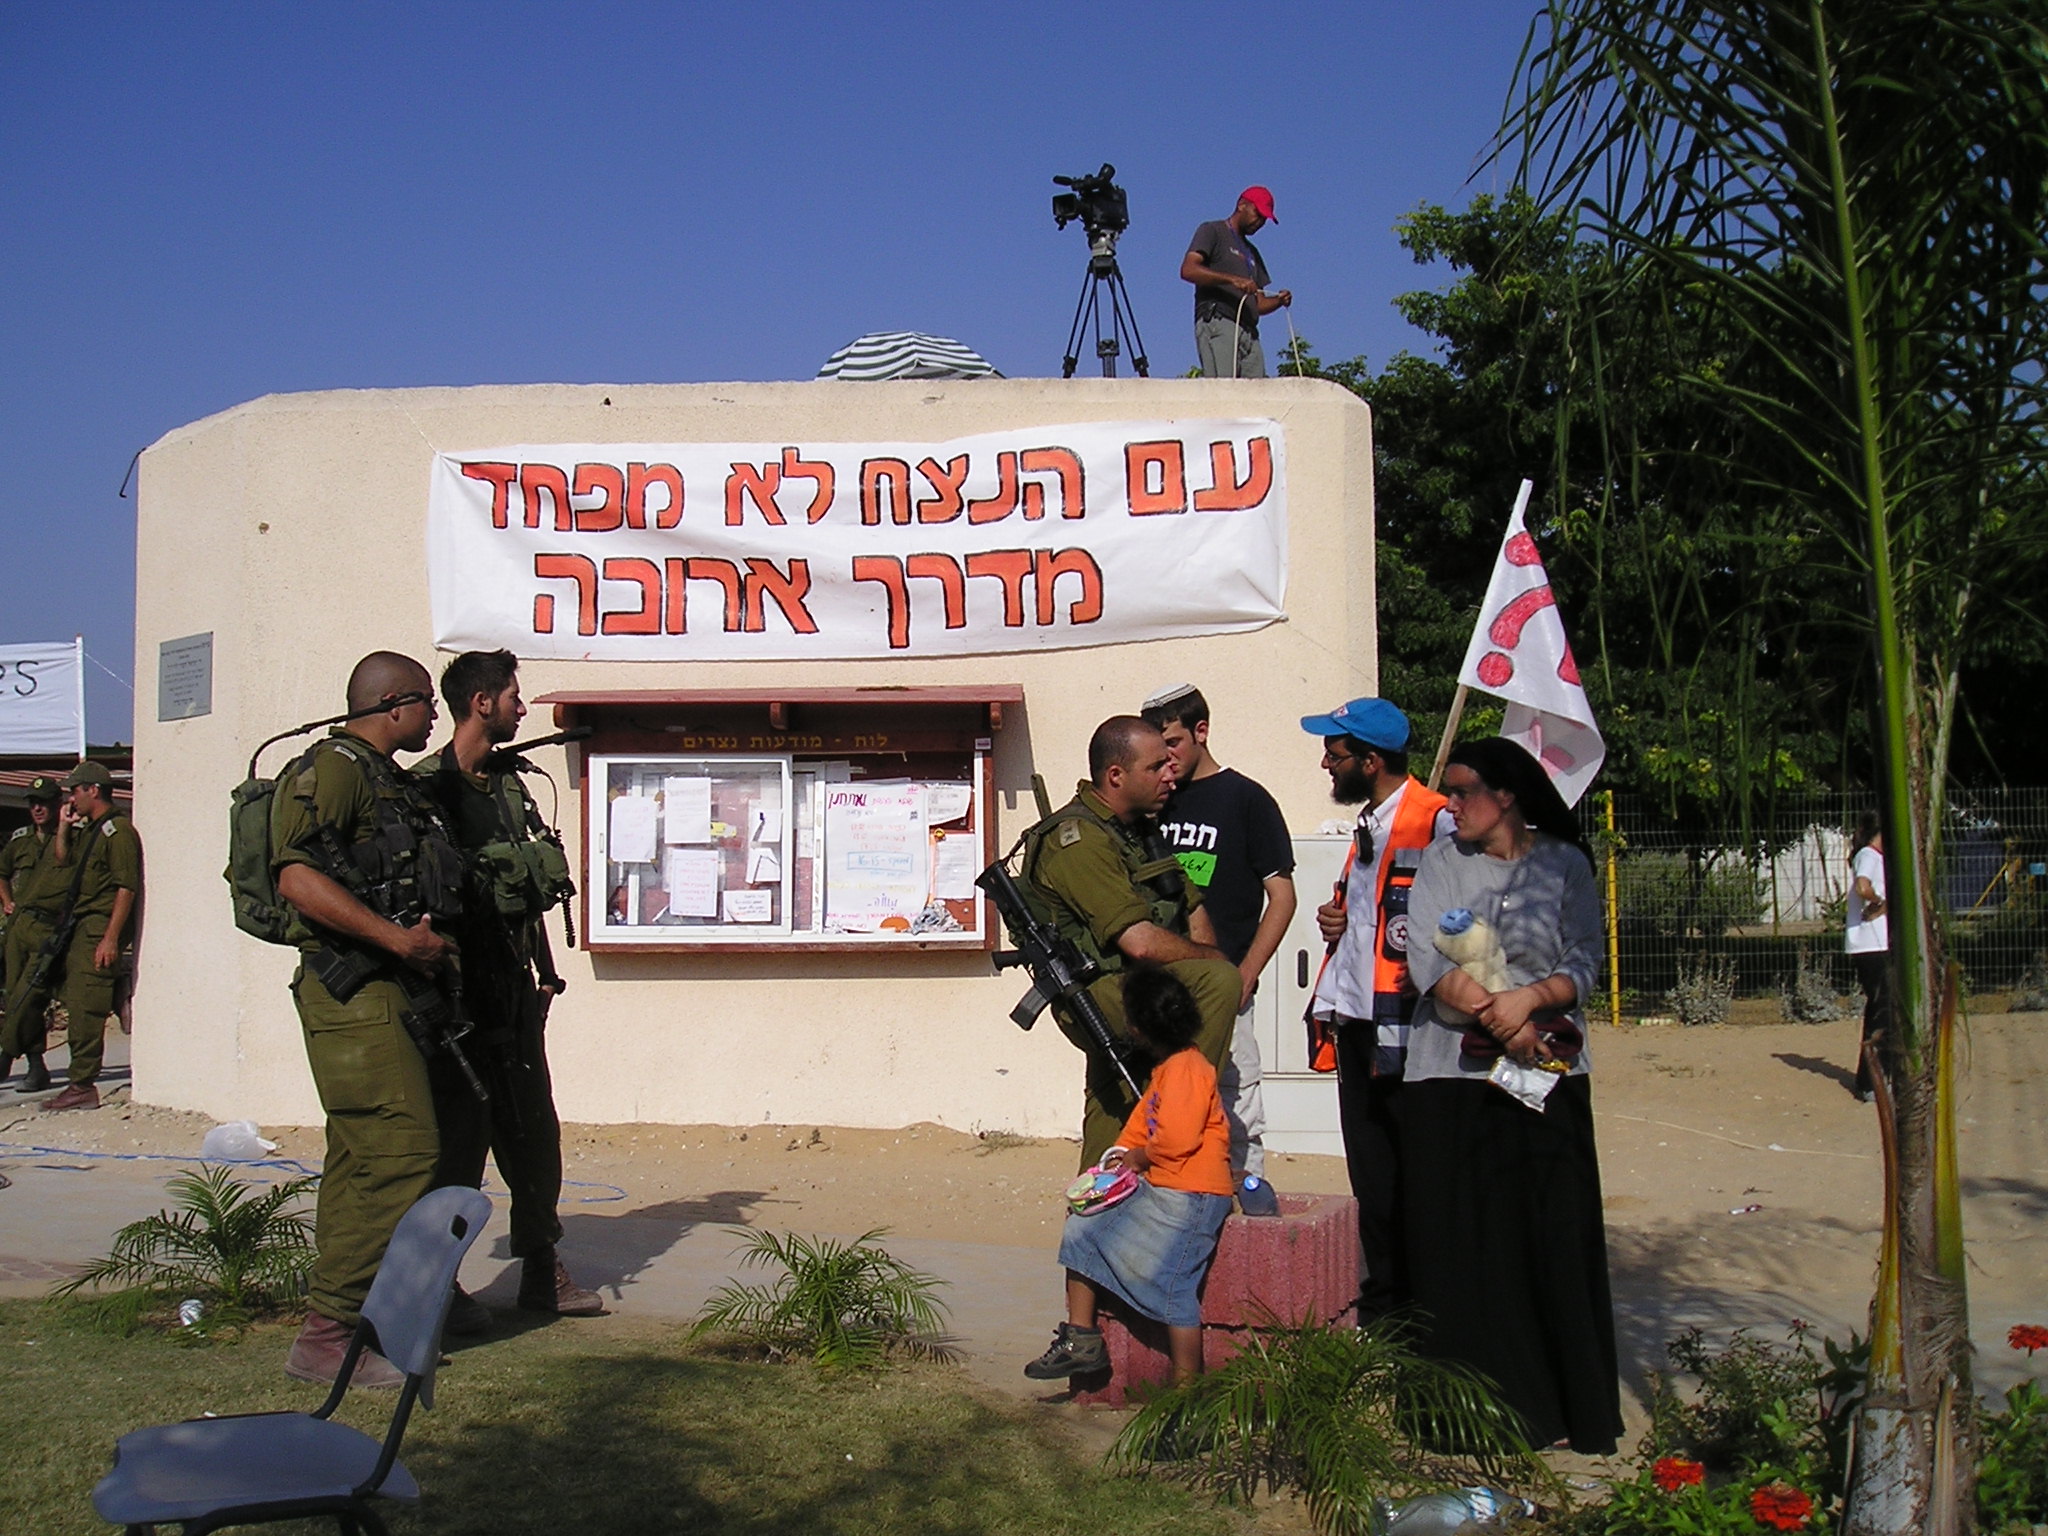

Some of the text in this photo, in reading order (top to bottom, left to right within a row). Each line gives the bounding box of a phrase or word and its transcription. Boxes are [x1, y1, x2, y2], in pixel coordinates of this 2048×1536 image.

[460, 436, 1275, 532] עם הנצח לא מפחד
[533, 546, 1104, 650] מדרך ארוכה
[683, 736, 738, 748] נצרים
[750, 736, 822, 748] מודעות
[854, 733, 888, 748] לוח
